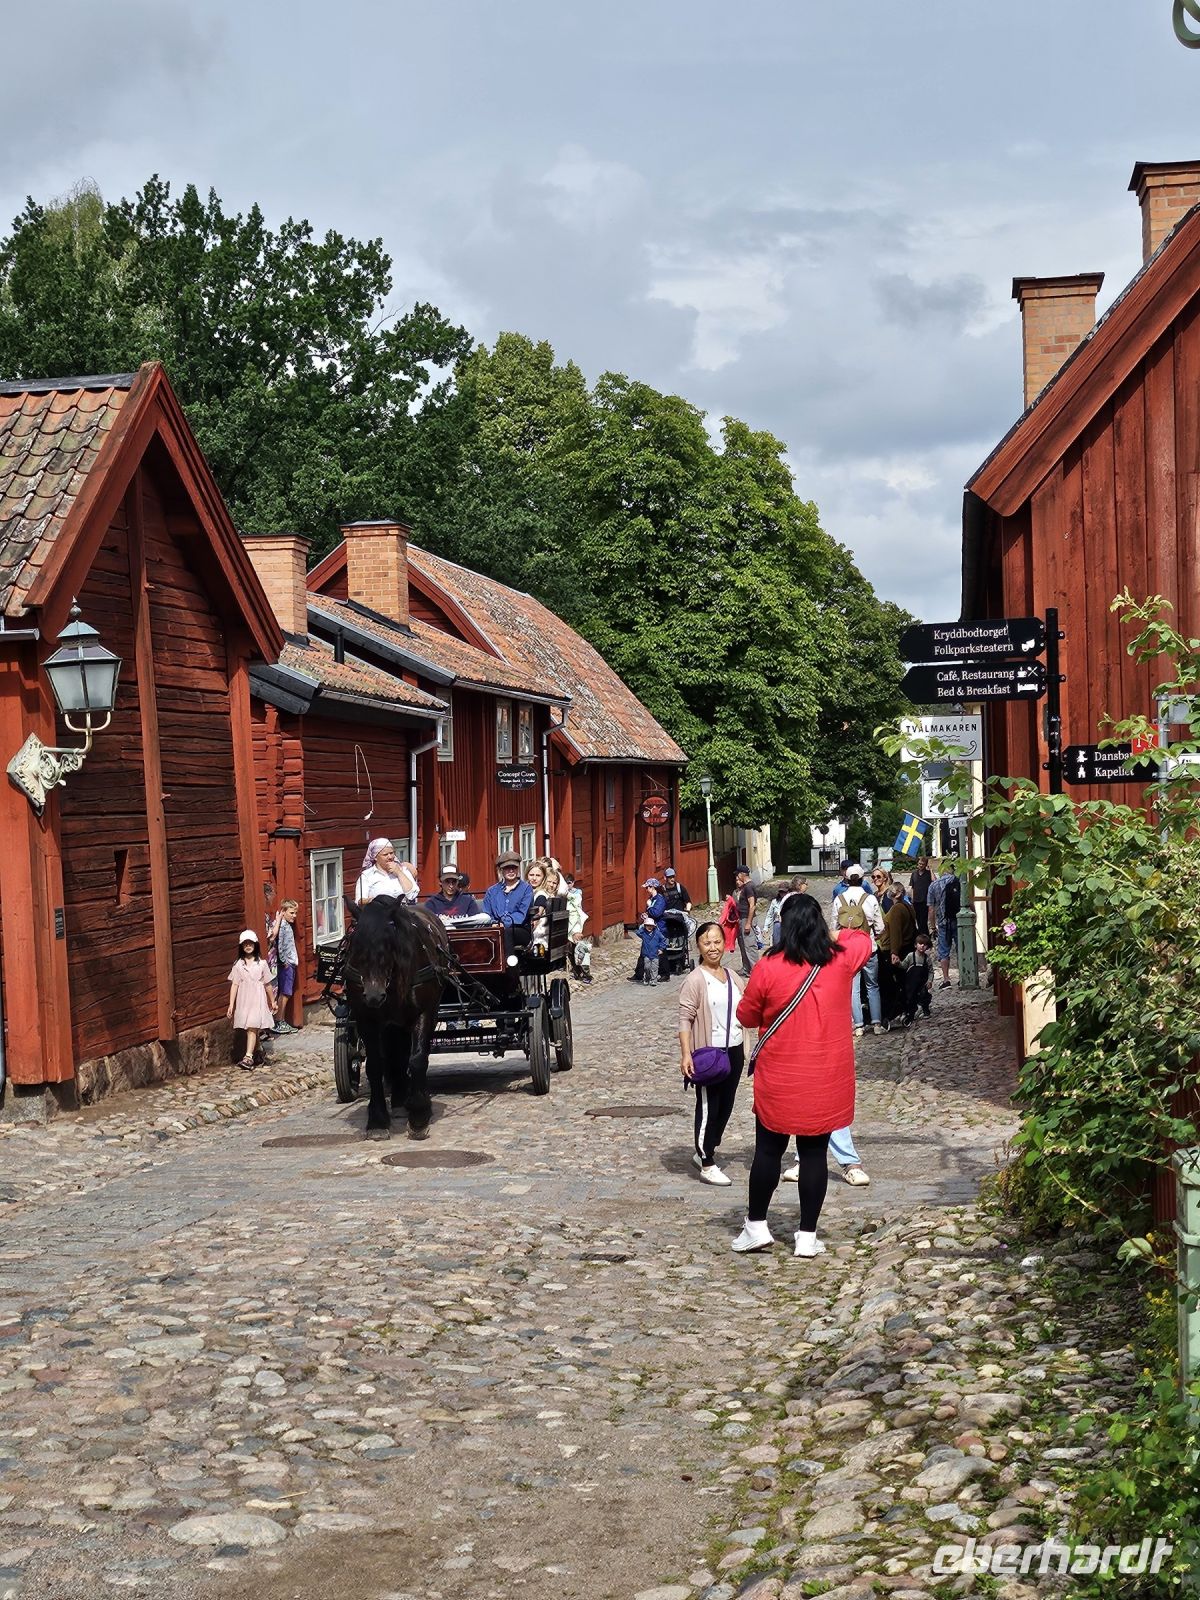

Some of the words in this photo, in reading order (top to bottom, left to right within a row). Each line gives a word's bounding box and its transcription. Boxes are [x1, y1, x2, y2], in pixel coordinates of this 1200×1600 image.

[934, 627, 1007, 641] Kryddbodtorget
[934, 643, 1014, 656] Folkparksteatern
[937, 671, 960, 682] Café,
[962, 670, 1015, 680] Restaurang
[938, 687, 955, 697] Bed
[957, 687, 965, 696] &
[967, 685, 1011, 696] Breakfast
